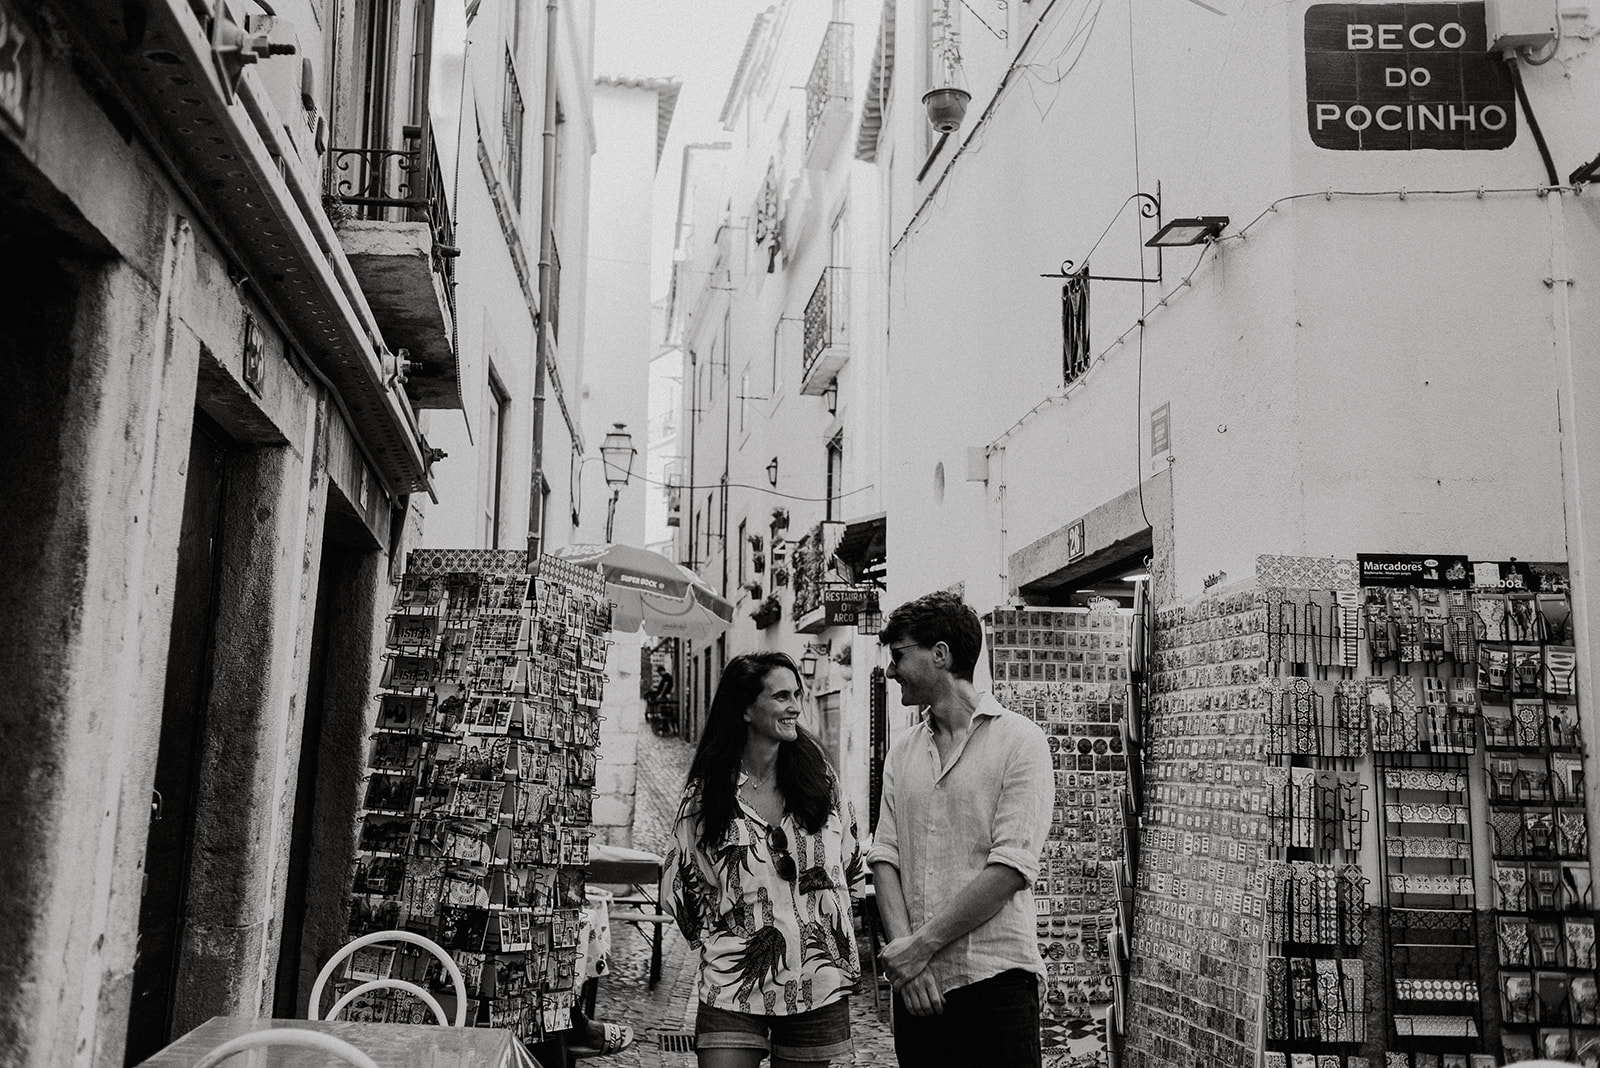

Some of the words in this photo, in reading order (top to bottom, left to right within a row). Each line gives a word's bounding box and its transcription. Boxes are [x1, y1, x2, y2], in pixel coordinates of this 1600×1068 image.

[1347, 23, 1467, 50] BECO
[1385, 67, 1431, 87] DO
[1316, 104, 1507, 131] POCINHO
[1070, 525, 1080, 556] 28
[1363, 561, 1423, 571] Marcadores
[620, 574, 640, 584] SUPER
[640, 577, 658, 588] BOCK
[833, 613, 854, 623] ARCO
